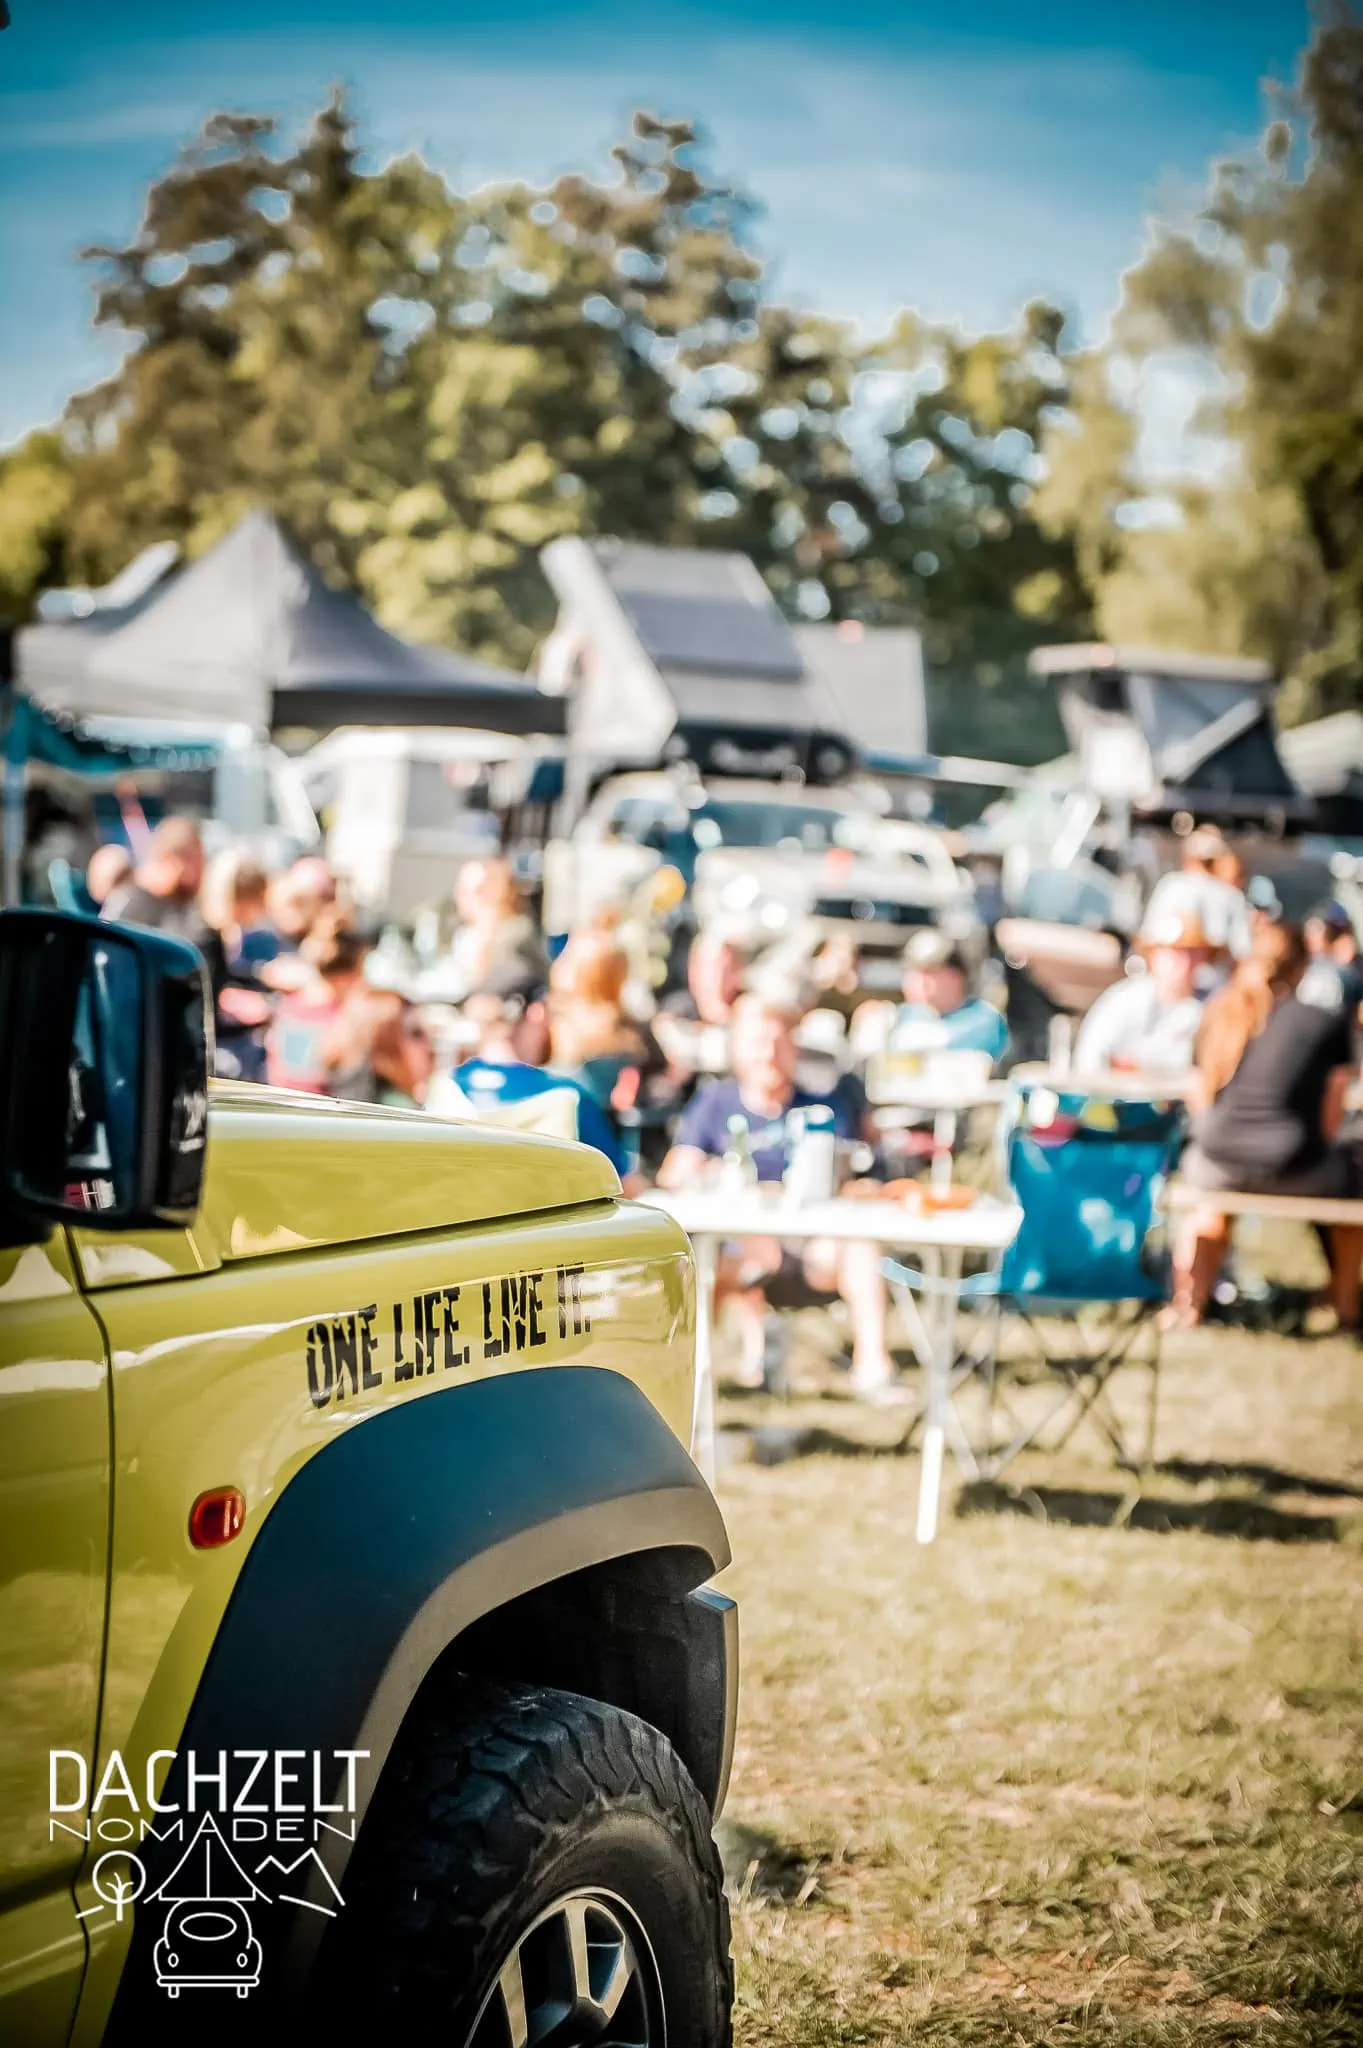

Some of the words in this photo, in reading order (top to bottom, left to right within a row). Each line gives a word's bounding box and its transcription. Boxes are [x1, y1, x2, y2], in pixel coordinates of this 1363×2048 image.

[307, 1303, 382, 1409] ONE
[393, 1286, 471, 1383] LIFE.
[482, 1268, 547, 1358] LIVE
